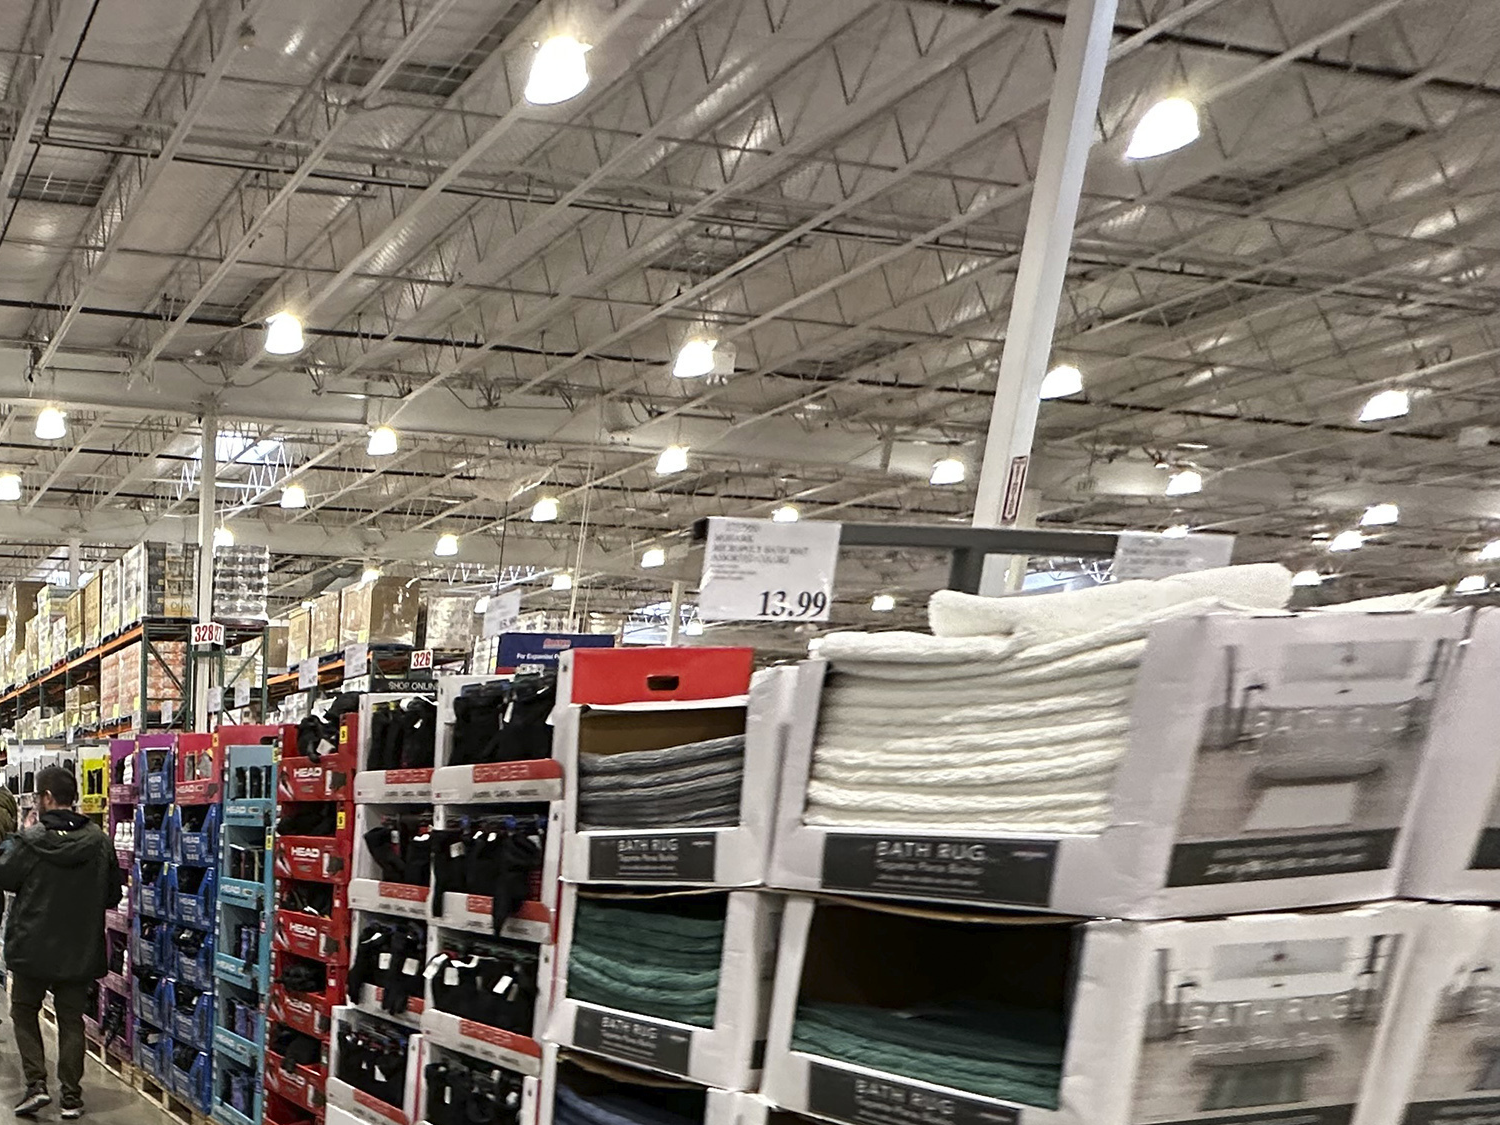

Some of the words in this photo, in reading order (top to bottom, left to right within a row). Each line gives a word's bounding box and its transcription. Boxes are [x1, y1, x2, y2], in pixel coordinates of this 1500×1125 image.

[757, 590, 828, 618] 13.99
[194, 624, 214, 643] 328
[413, 651, 431, 668] 326
[526, 653, 554, 661] Expanded
[388, 681, 410, 690] SHOP
[293, 766, 323, 779] HEAD
[386, 769, 429, 782] SPYDER
[473, 764, 530, 781] SPYDER
[225, 805, 247, 814] HEAD
[290, 846, 321, 859] HEAD
[618, 839, 649, 852] BATH
[651, 838, 679, 851] RUG
[875, 840, 932, 858] BATH
[936, 843, 987, 862] RUG
[288, 922, 318, 938] HEAD
[633, 1023, 658, 1040] RUG
[910, 1092, 955, 1116] RUG
